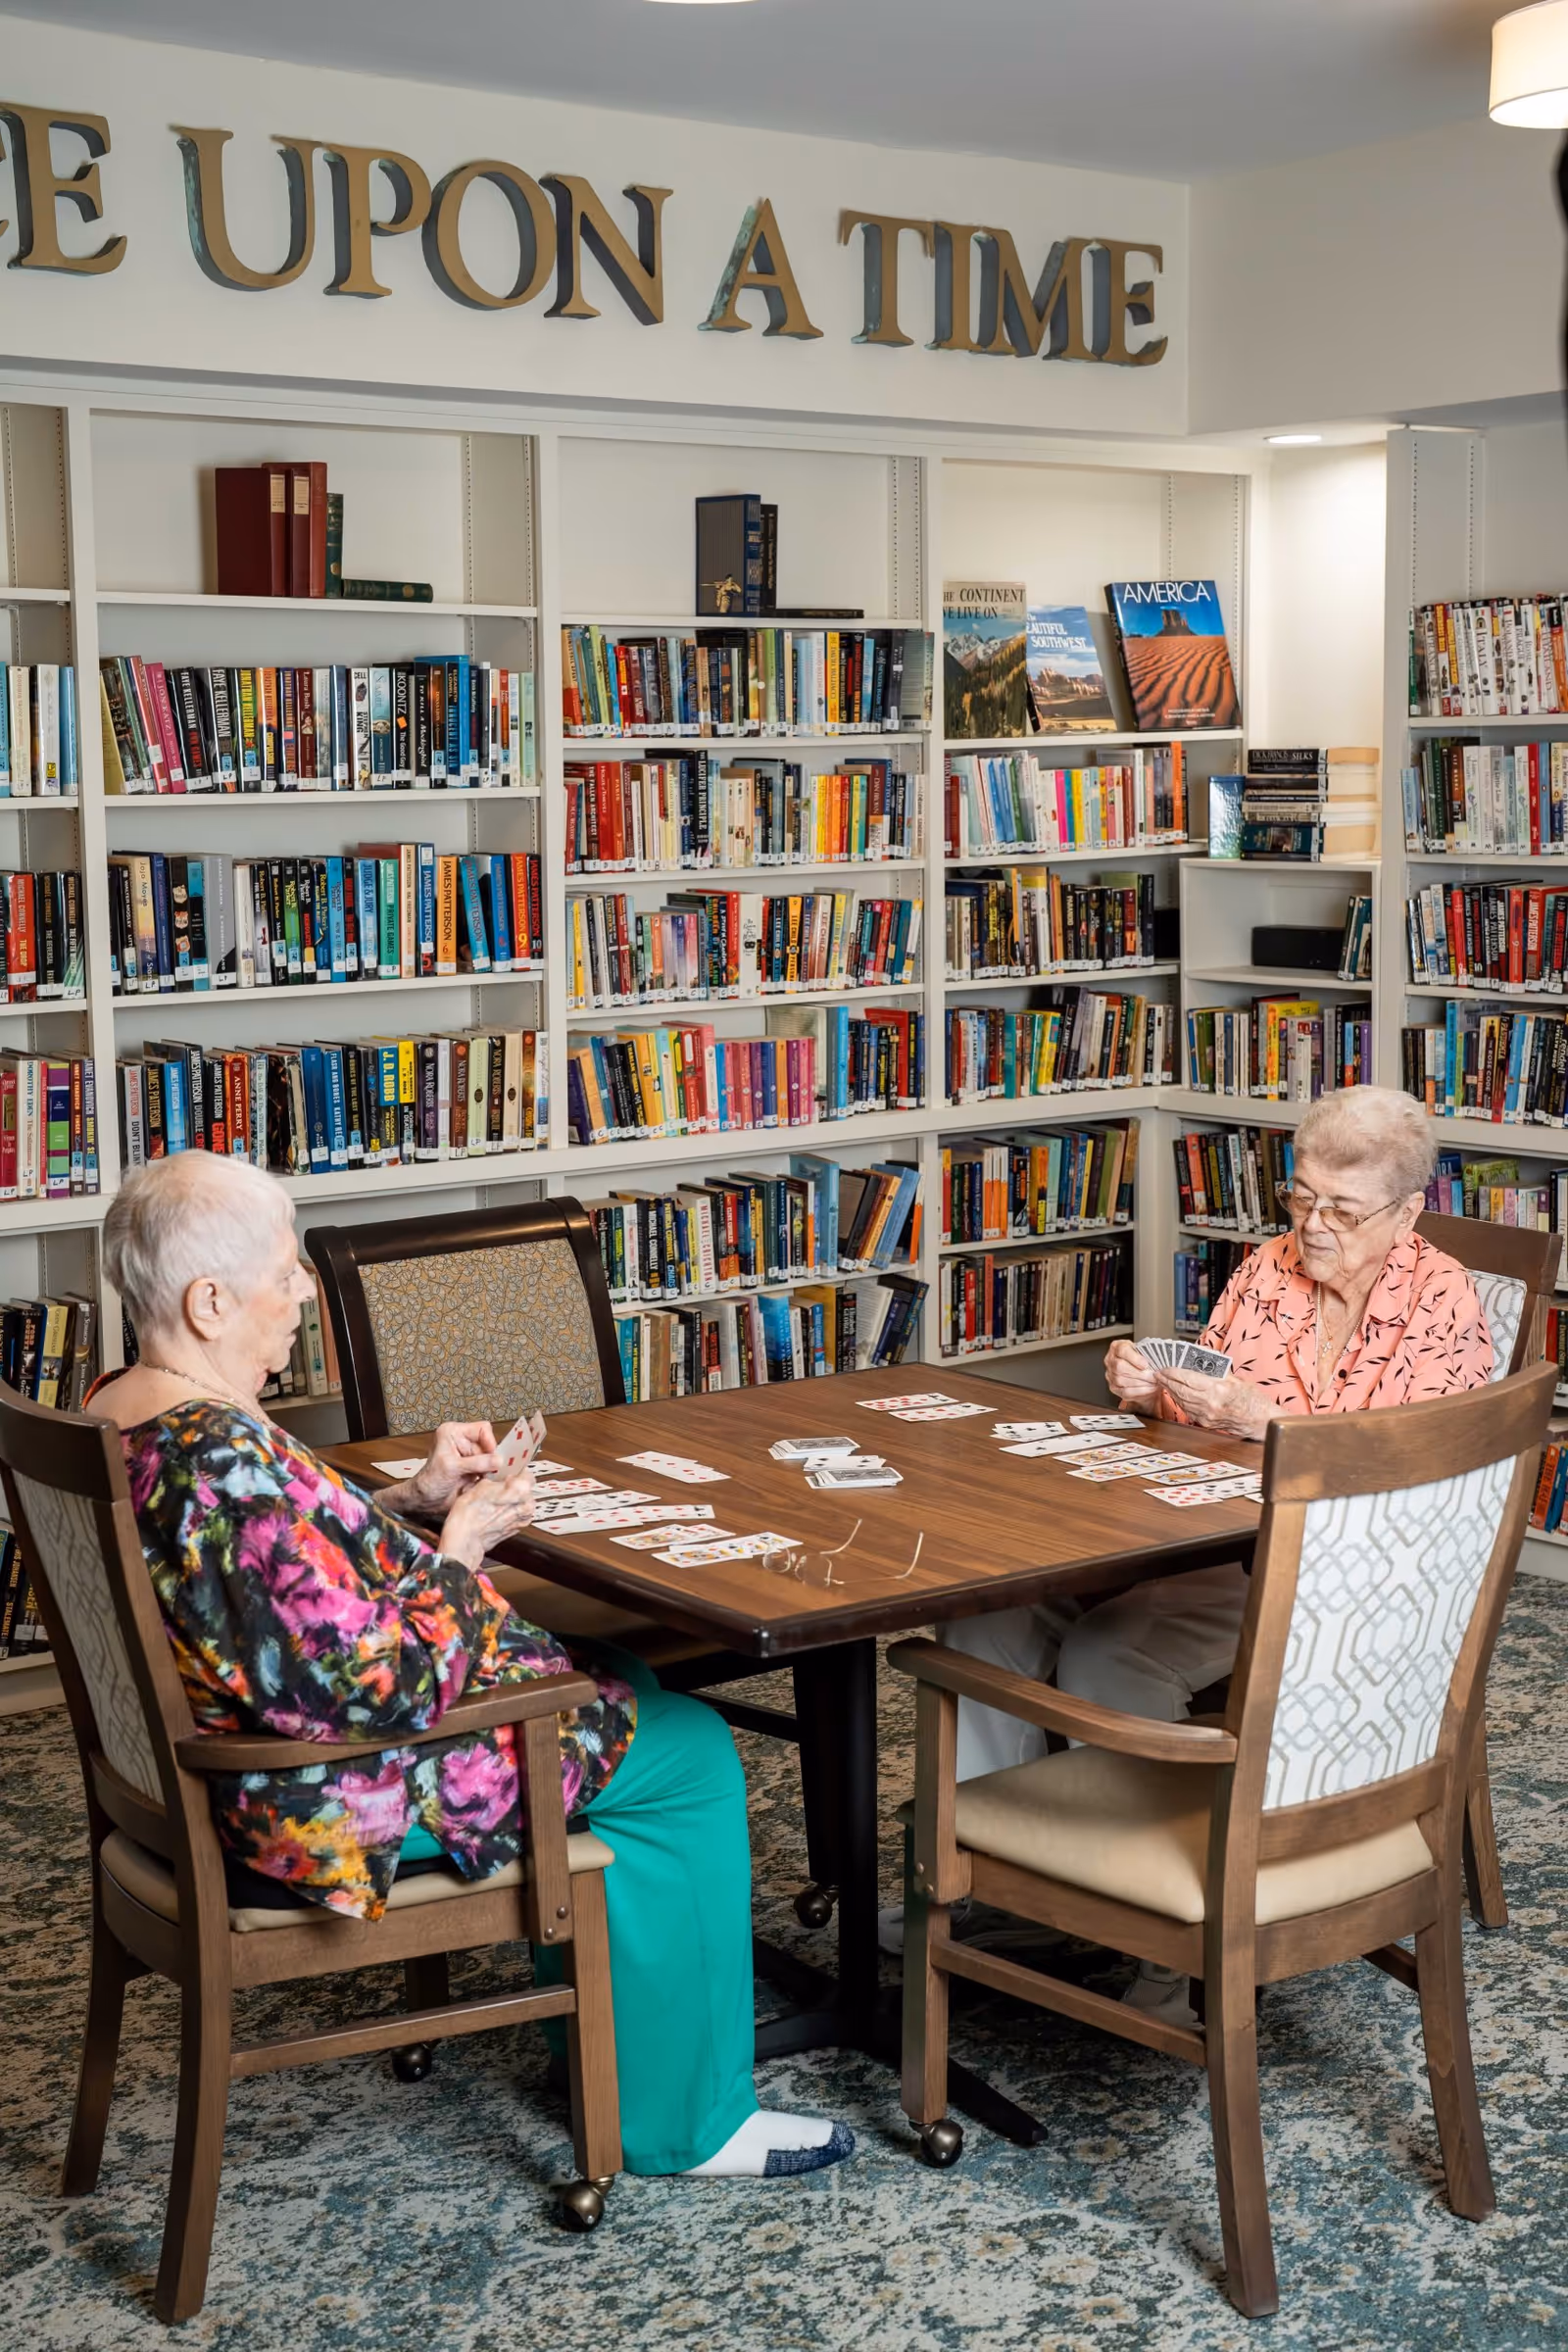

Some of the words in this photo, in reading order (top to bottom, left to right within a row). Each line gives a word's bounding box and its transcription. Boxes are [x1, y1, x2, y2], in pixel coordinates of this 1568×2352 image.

[0, 104, 127, 276] E
[168, 123, 674, 326] UPON
[697, 198, 824, 340] A
[837, 209, 1169, 368] TIME
[943, 591, 955, 602] HE
[959, 588, 1025, 603] CONTINENT
[1123, 582, 1211, 604] AMERICA
[956, 607, 981, 619] LIVE
[984, 607, 998, 619] ON
[1027, 622, 1068, 636] EAUTIFUL
[1031, 635, 1087, 649] SOUTHWEST
[1477, 632, 1487, 667] ITALY
[181, 671, 191, 689] FAYE
[214, 669, 226, 689] FAYE
[241, 669, 253, 702] JONATHAN
[303, 672, 312, 692] Laura
[419, 684, 424, 693] TO
[396, 676, 409, 714] KOONTZ
[183, 690, 198, 730] KELLERMAN
[216, 690, 232, 738] KELLERMAN
[243, 703, 256, 738] KELLERMAN
[418, 725, 427, 768] Mockingbird
[1292, 751, 1313, 760] SILKS
[698, 761, 708, 791] LUCIFER
[589, 803, 598, 836] ARCHITECT
[699, 793, 708, 831] PRINCIPLE
[363, 864, 372, 889] JUDGE
[423, 870, 432, 898] JAMES
[443, 860, 452, 884] JAMES
[529, 859, 539, 887] JAMES
[18, 878, 26, 904] MICHAEL
[140, 882, 149, 907] Moyes
[365, 899, 374, 913] JURY
[386, 905, 395, 931] PRIVATE
[443, 885, 453, 941] PATTERSON
[516, 884, 526, 933] PATTERSON
[531, 888, 541, 937] PATTERSON
[18, 905, 27, 934] CONNELLY
[423, 899, 433, 943] PATTERSO
[386, 932, 396, 956] GAMES
[442, 943, 449, 956] 6
[518, 933, 527, 949] 9
[532, 939, 542, 949] 10
[422, 954, 432, 968] 5
[68, 988, 81, 998] LP
[85, 1058, 94, 1079] JANET
[191, 1050, 201, 1070] JAMES
[383, 1052, 394, 1060] J.
[383, 1063, 394, 1073] D.
[457, 1060, 466, 1077] NORA
[492, 1050, 501, 1068] NORA
[214, 1061, 222, 1082] JAMES
[425, 1063, 434, 1082] NORA
[492, 1069, 502, 1096] ROBERTS
[86, 1080, 95, 1115] EVANOVICH
[191, 1070, 203, 1103] PATTERSON
[234, 1076, 243, 1101] ANNE
[383, 1074, 395, 1102] ROBB
[424, 1083, 435, 1108] ROBERTS
[457, 1078, 466, 1102] ROBERTS
[215, 1083, 223, 1119] PATTERSON
[193, 1104, 204, 1133] DOUBLE
[234, 1102, 244, 1130] PERRY
[130, 1121, 140, 1141] DON'T
[212, 1122, 225, 1154] GONE
[649, 1210, 658, 1238] MICHAEL
[663, 1202, 672, 1228] PATRICIA
[700, 1205, 710, 1240] MICHAEL
[649, 1239, 659, 1270] CONNELLY
[664, 1230, 674, 1261] CORNWELL
[666, 1264, 676, 1288] CHAOS
[52, 1325, 61, 1353] GRISHAM
